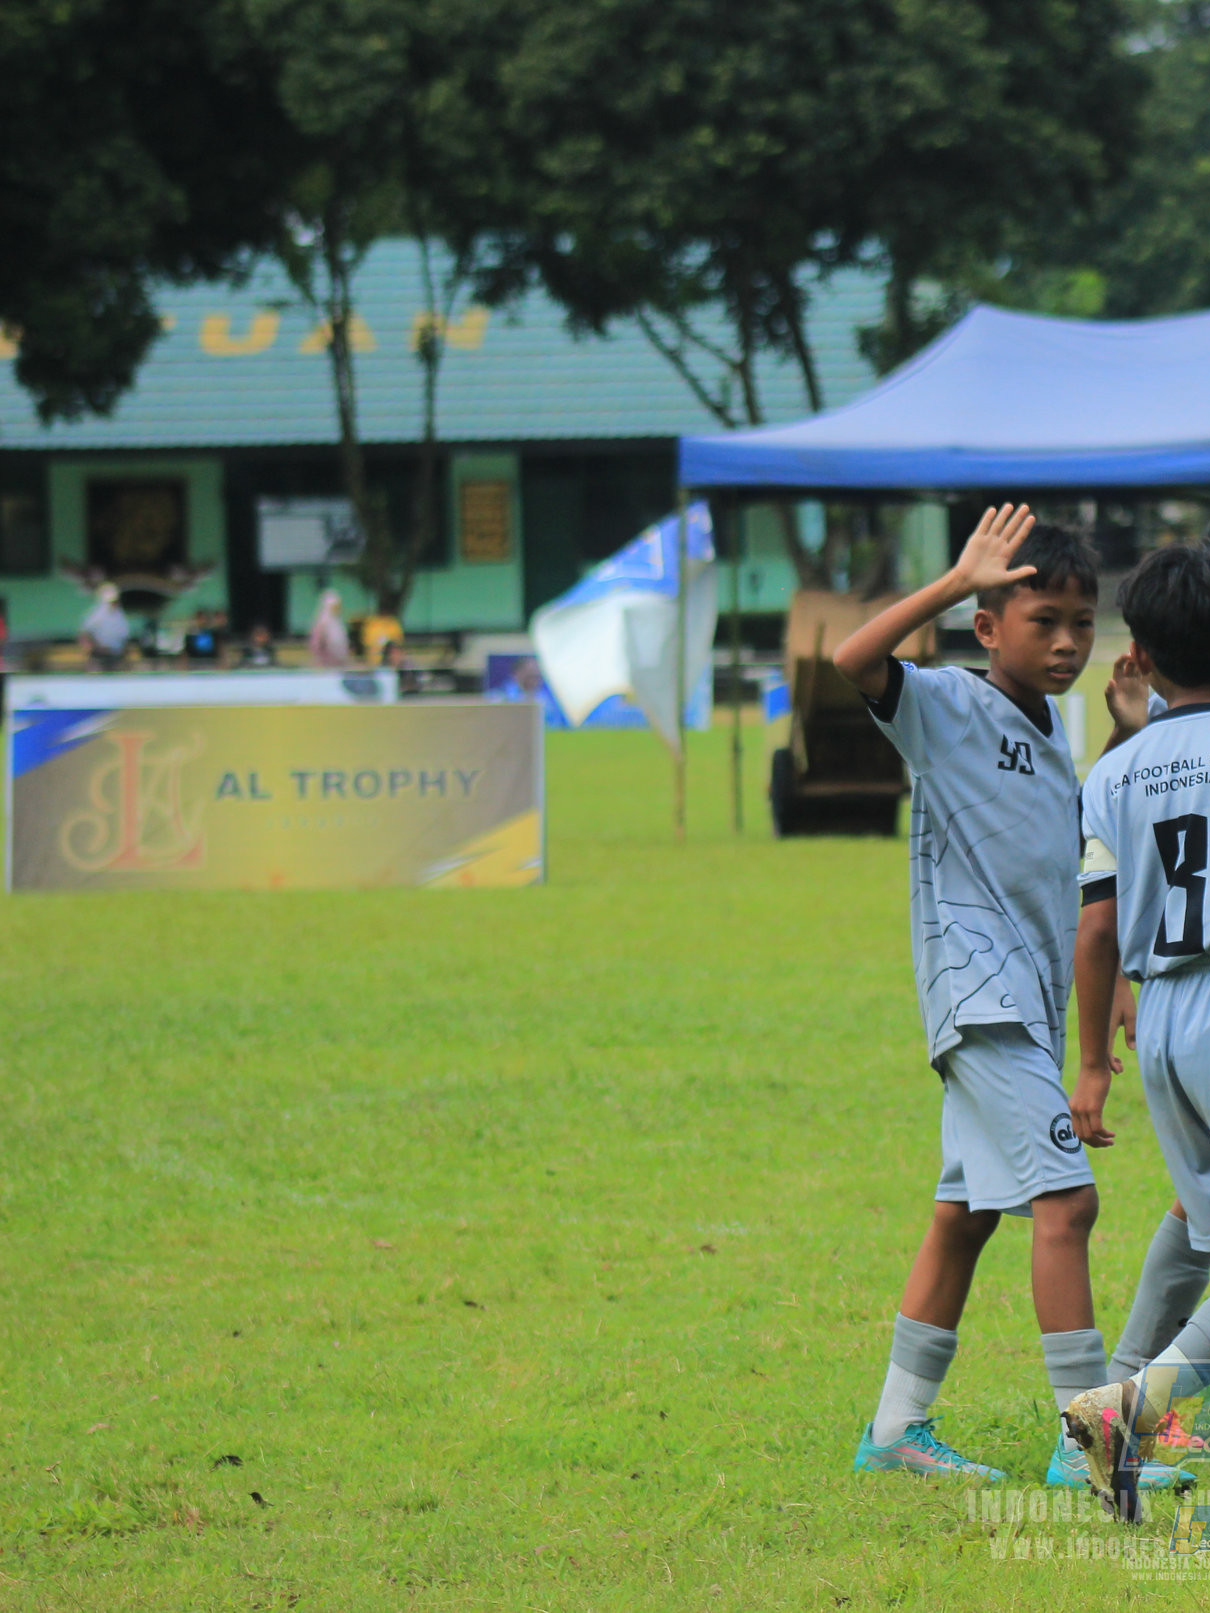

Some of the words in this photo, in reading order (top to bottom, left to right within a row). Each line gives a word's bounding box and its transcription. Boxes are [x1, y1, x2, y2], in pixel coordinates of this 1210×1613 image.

[215, 771, 273, 800] AL
[290, 768, 480, 799] TROPHY
[1133, 756, 1206, 783] FOOTBALL
